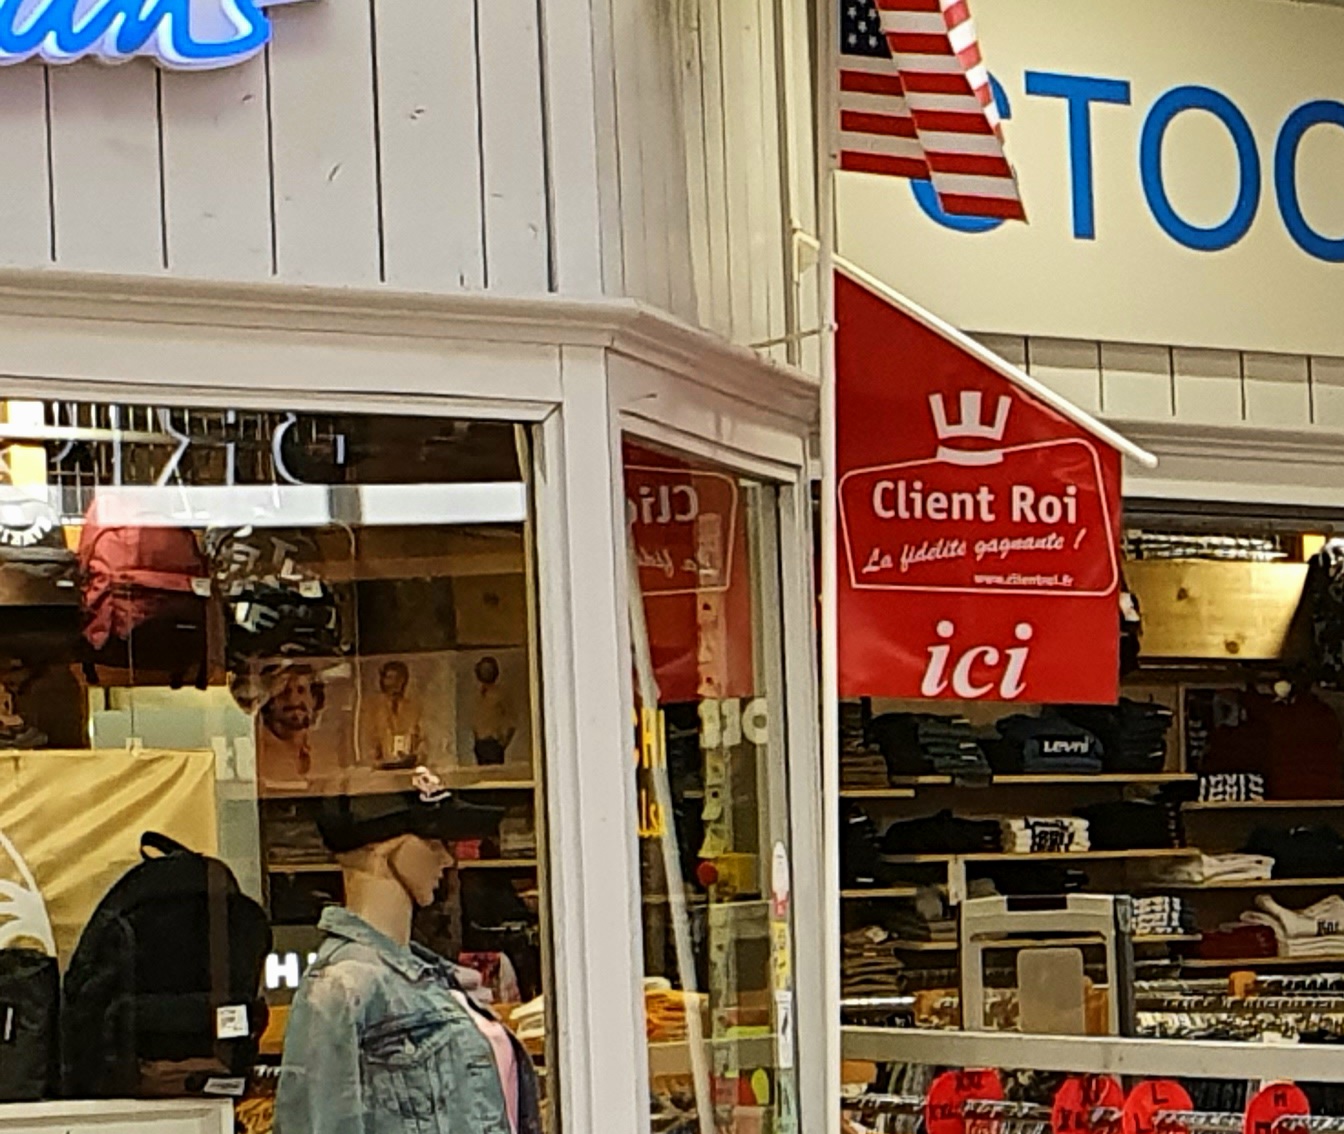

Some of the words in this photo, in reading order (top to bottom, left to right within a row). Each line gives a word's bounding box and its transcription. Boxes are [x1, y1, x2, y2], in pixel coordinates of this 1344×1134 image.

[872, 480, 996, 523] Client
[1011, 484, 1078, 525] Roi
[861, 547, 894, 574] La
[920, 619, 1034, 700] ici
[1151, 1083, 1169, 1105] L
